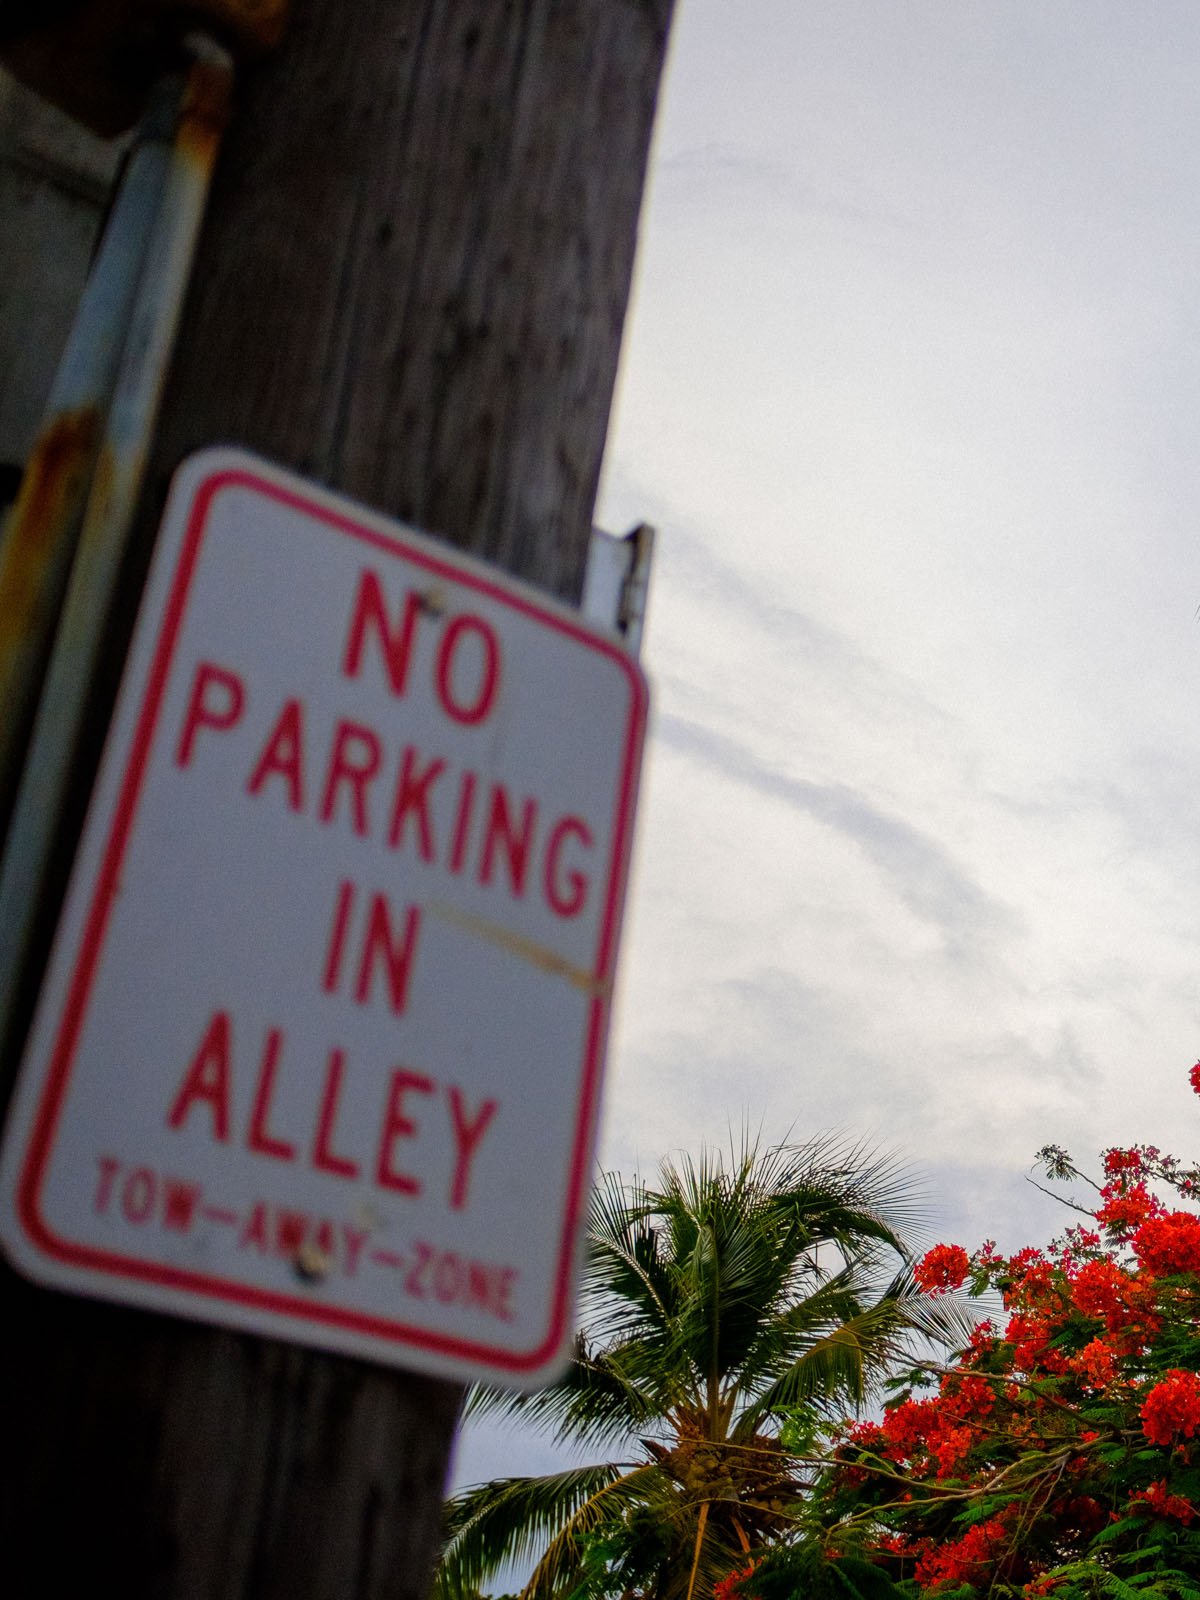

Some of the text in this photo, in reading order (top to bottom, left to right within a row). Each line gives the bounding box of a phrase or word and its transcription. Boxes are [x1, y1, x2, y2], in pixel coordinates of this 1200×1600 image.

[343, 566, 499, 726] NO
[174, 662, 593, 918] PARKING
[321, 879, 421, 1017] IN
[166, 1010, 498, 1211] ALLEY
